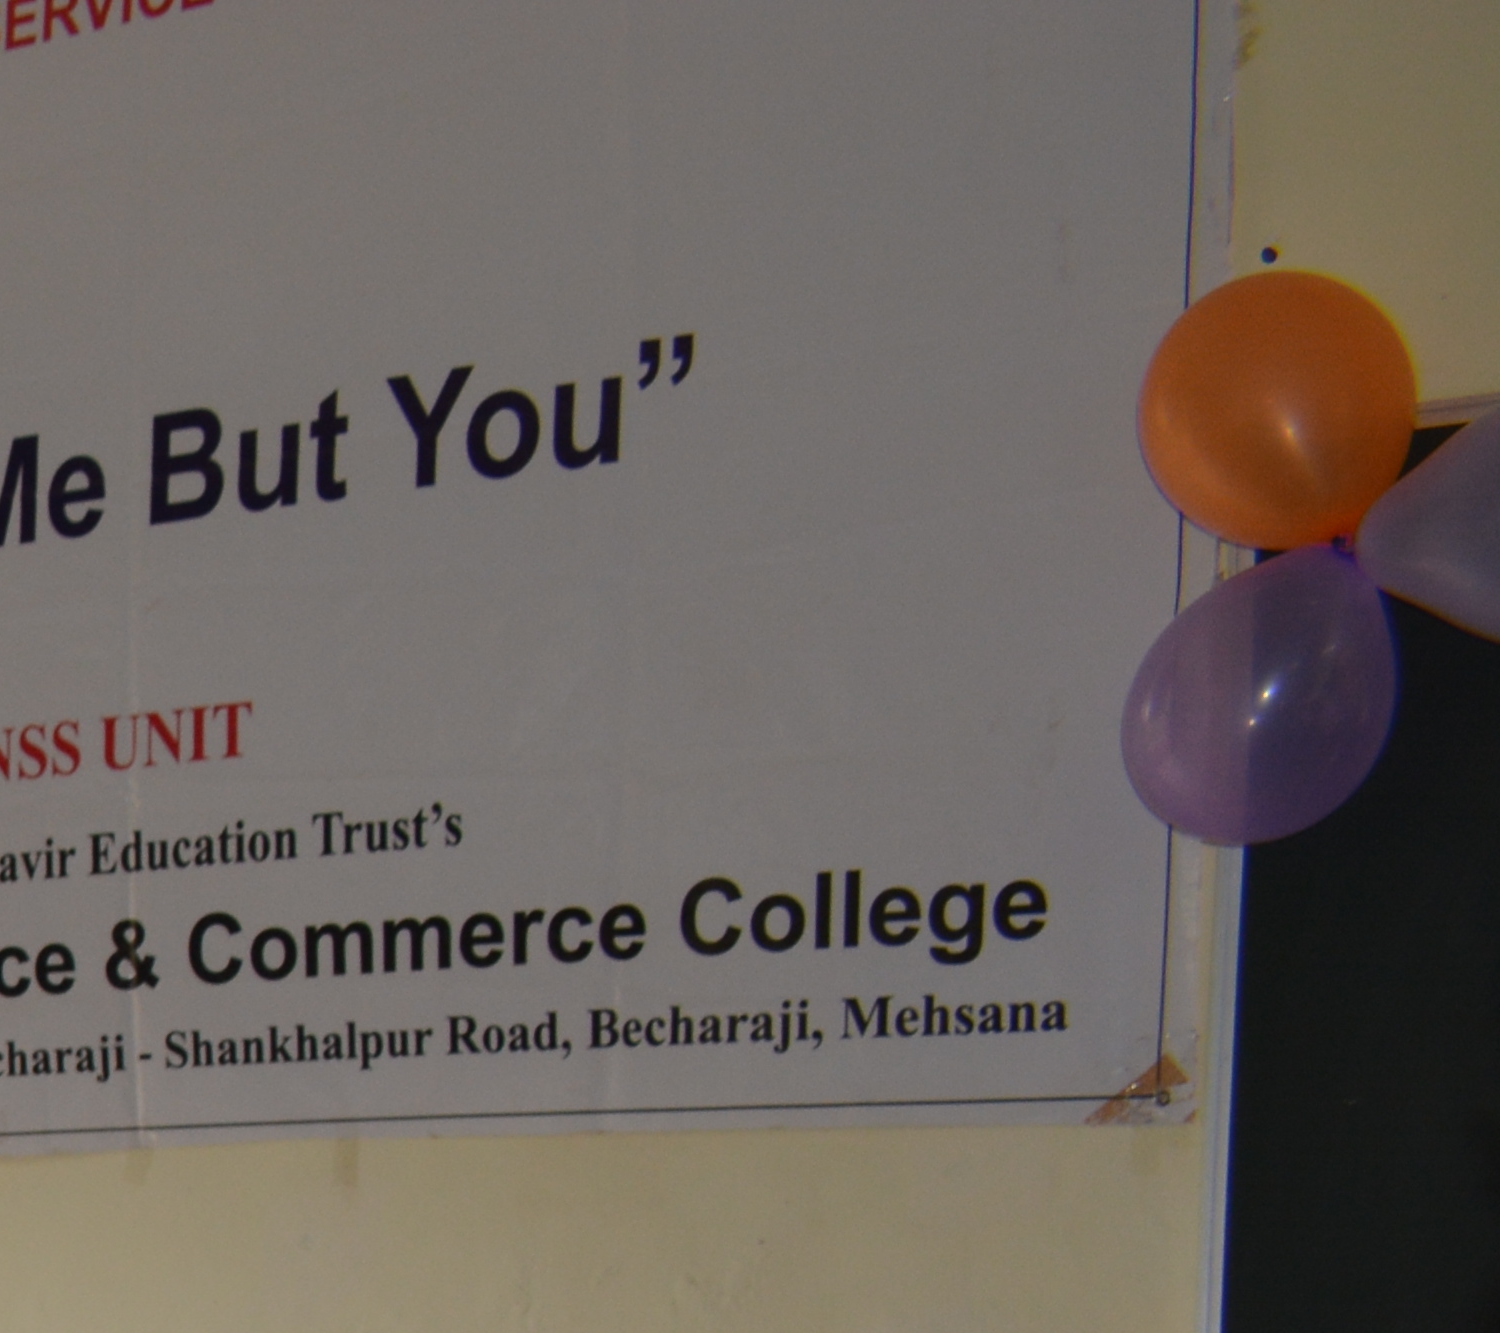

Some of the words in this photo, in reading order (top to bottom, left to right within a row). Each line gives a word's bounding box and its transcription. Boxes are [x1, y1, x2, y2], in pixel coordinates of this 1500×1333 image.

[149, 388, 351, 528] But
[102, 701, 256, 773] UNIT
[90, 820, 299, 878] Education
[105, 918, 161, 992] &
[188, 904, 649, 986] Commerce
[679, 868, 1050, 967] College
[165, 1022, 435, 1072] Shankhalpur
[448, 1011, 574, 1058] Road,
[589, 1000, 825, 1056] Becharaji,
[842, 995, 1069, 1041] Mehsana
